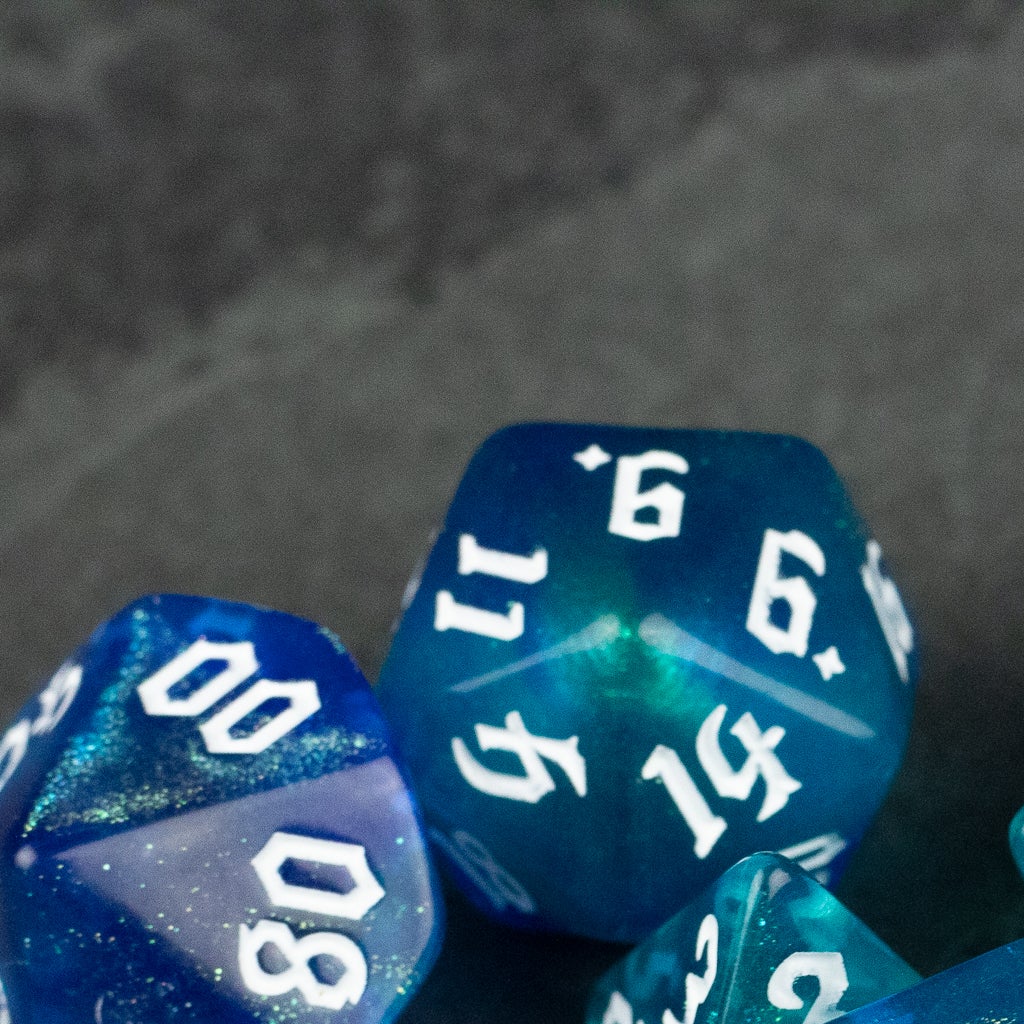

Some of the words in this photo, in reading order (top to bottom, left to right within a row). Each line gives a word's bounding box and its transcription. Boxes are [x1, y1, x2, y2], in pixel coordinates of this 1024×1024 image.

[434, 533, 549, 642] 11
[745, 528, 826, 658] 6
[136, 635, 322, 756] 00
[451, 710, 588, 804] 4
[641, 703, 803, 860] 14
[237, 830, 387, 1012] 80
